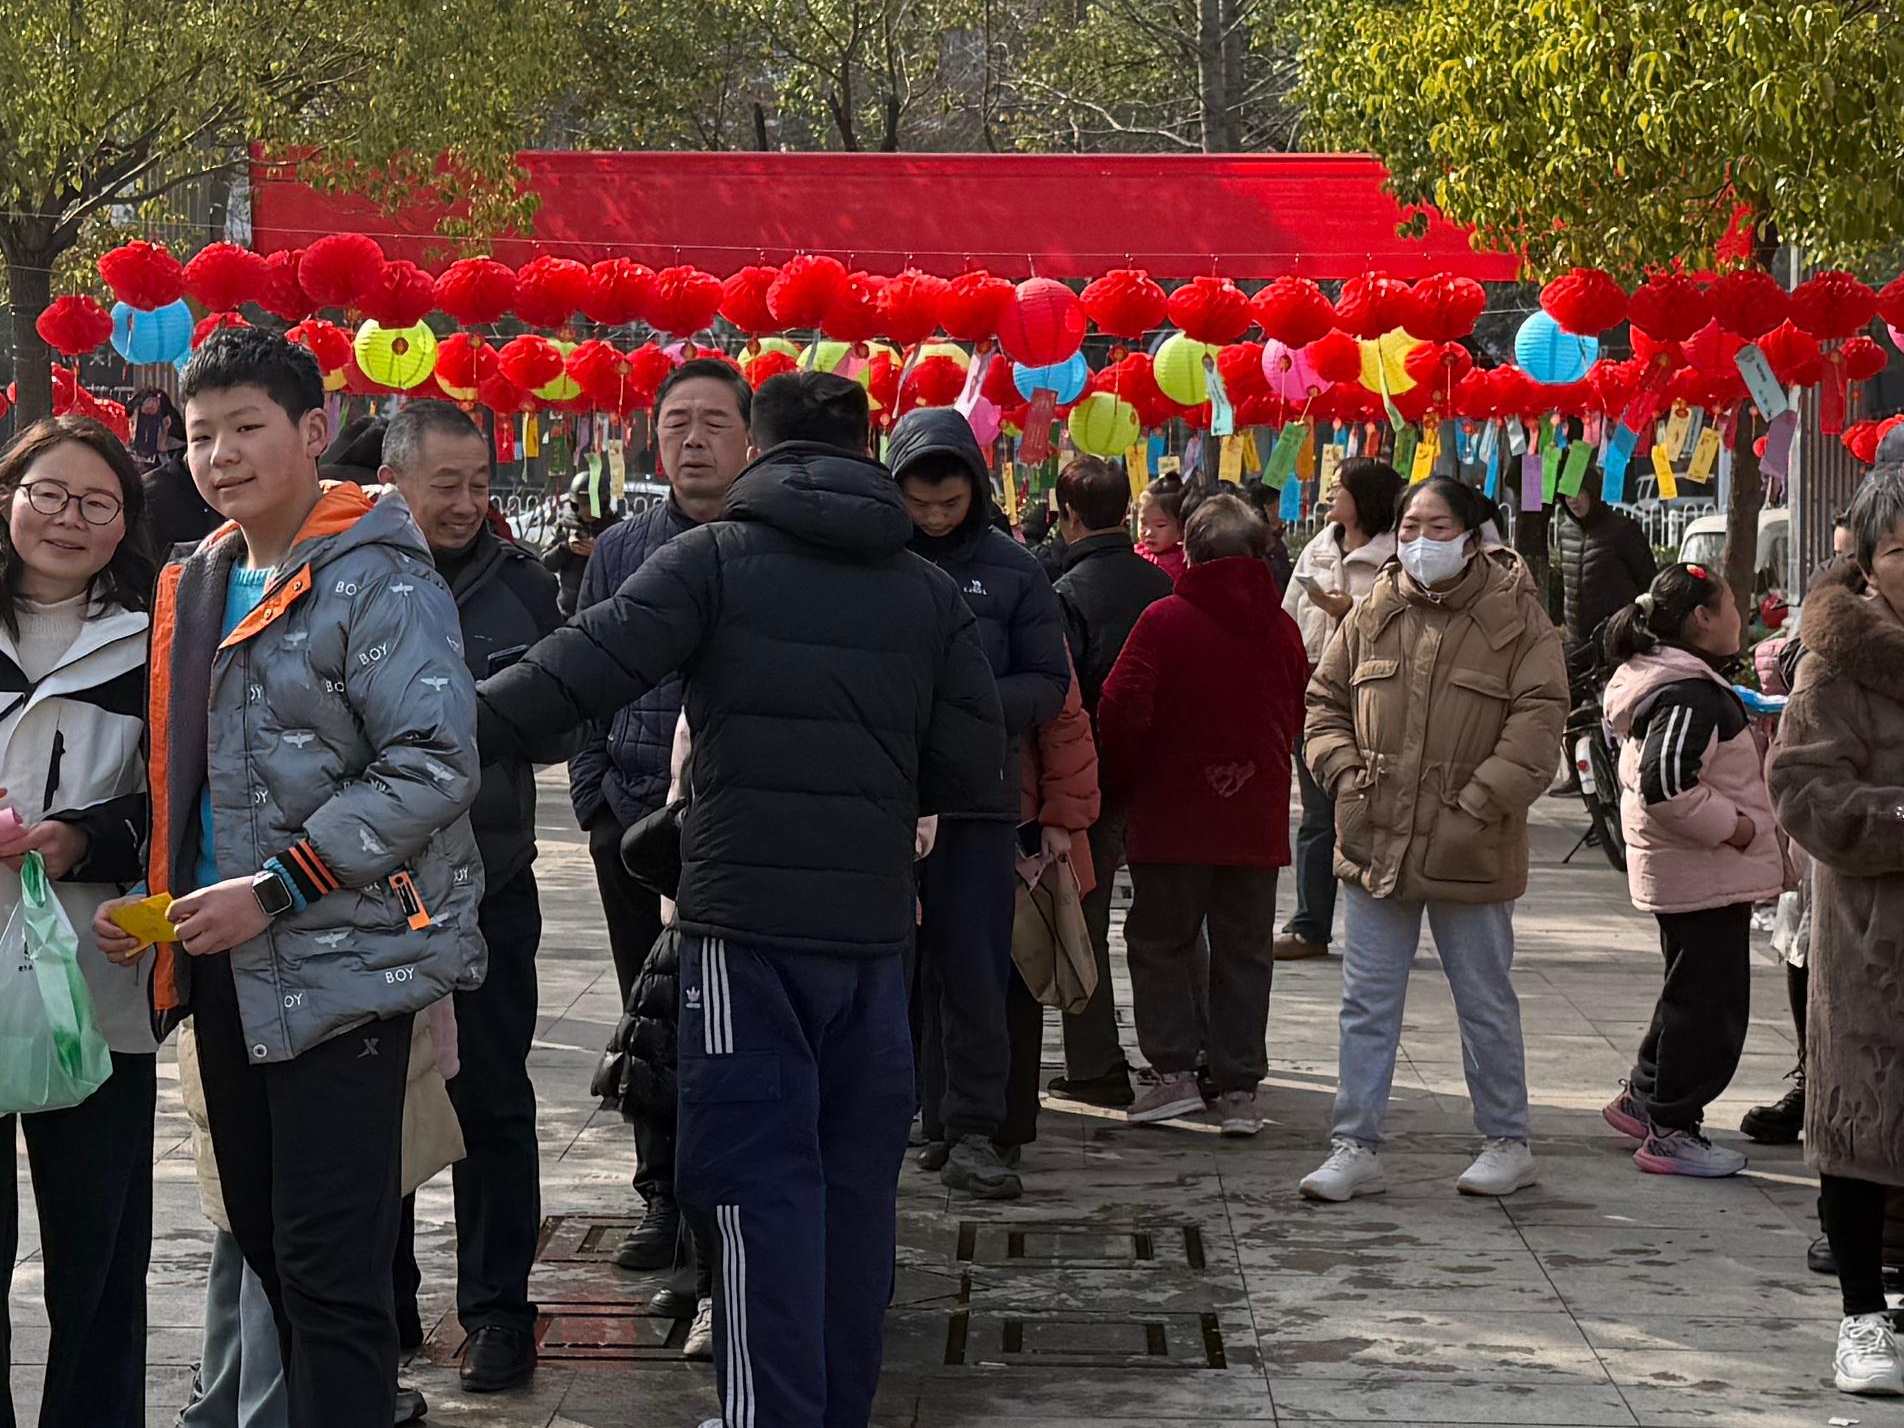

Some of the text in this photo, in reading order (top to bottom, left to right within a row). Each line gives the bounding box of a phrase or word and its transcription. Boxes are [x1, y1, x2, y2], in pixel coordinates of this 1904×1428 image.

[335, 580, 358, 597] BO
[358, 643, 388, 667] BOY
[385, 967, 415, 984] BOY
[283, 993, 303, 1008] OY
